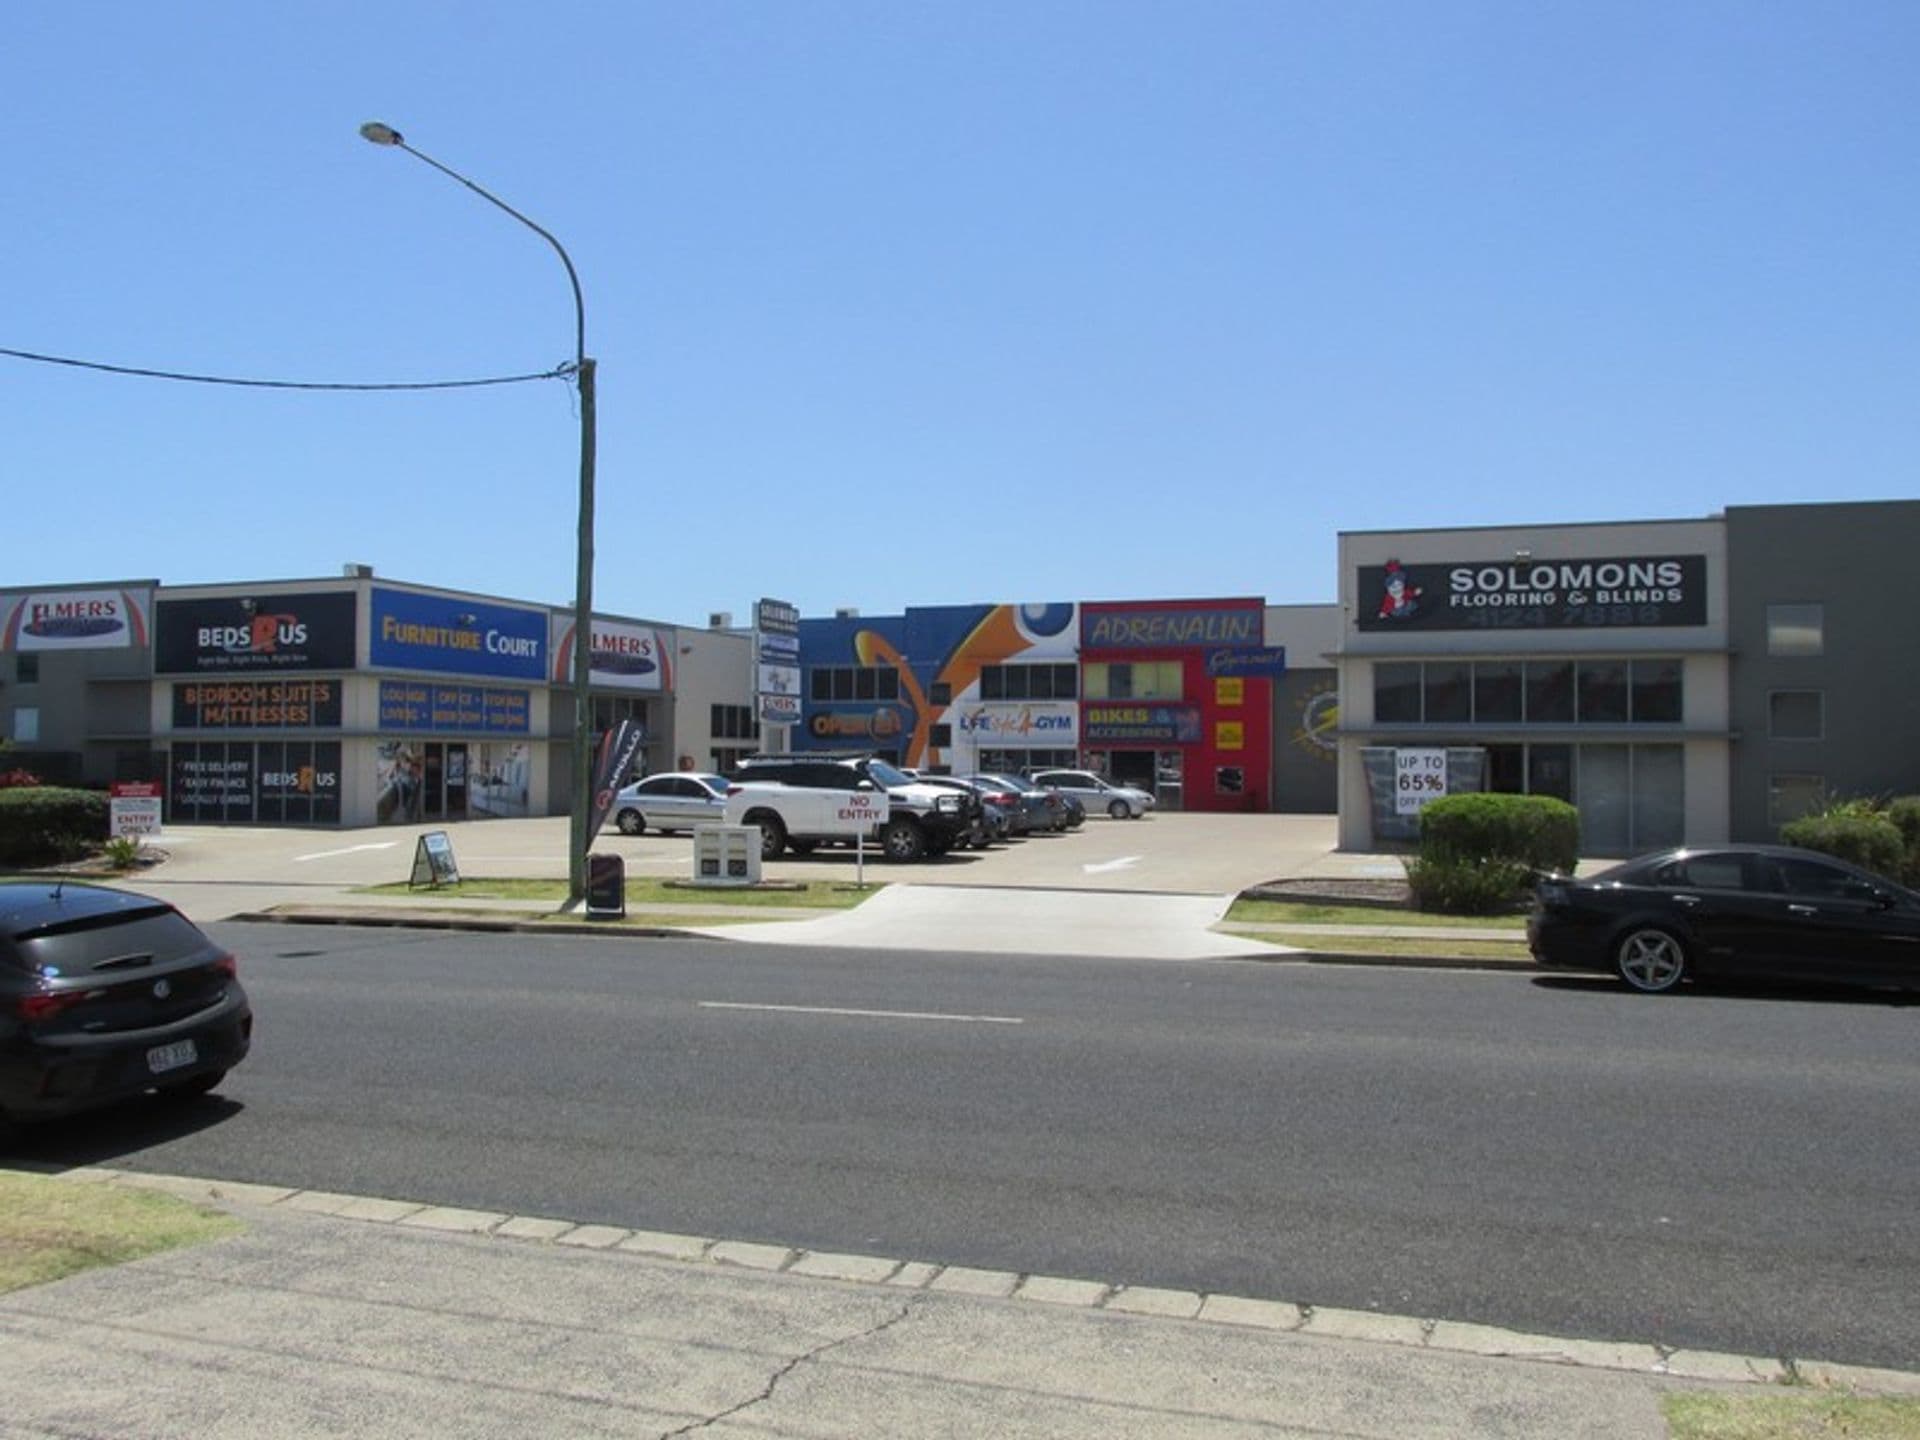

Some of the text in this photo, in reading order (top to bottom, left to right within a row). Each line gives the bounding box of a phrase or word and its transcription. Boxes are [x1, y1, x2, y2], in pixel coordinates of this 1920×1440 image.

[1450, 562, 1683, 592] SOLOMONS
[1450, 588, 1683, 607] FLOORING & BLINDS
[31, 600, 117, 628] ELMERS
[198, 625, 251, 648] BEDS
[279, 623, 308, 645] US
[382, 615, 539, 657] FURNITURE COURT
[1091, 615, 1250, 643] ADRENALIN
[592, 633, 651, 656] LMERS
[184, 683, 331, 704] BEDROOM SUITES
[204, 705, 309, 723] MATTRESSES
[1088, 708, 1149, 724] BIKES
[1036, 716, 1071, 731] GYM
[1399, 756, 1443, 769] UP TO
[262, 772, 298, 786] BEDS
[316, 772, 336, 787] US
[1399, 773, 1444, 791] 65%
[850, 795, 870, 807] NO
[838, 808, 881, 820] ENTRY
